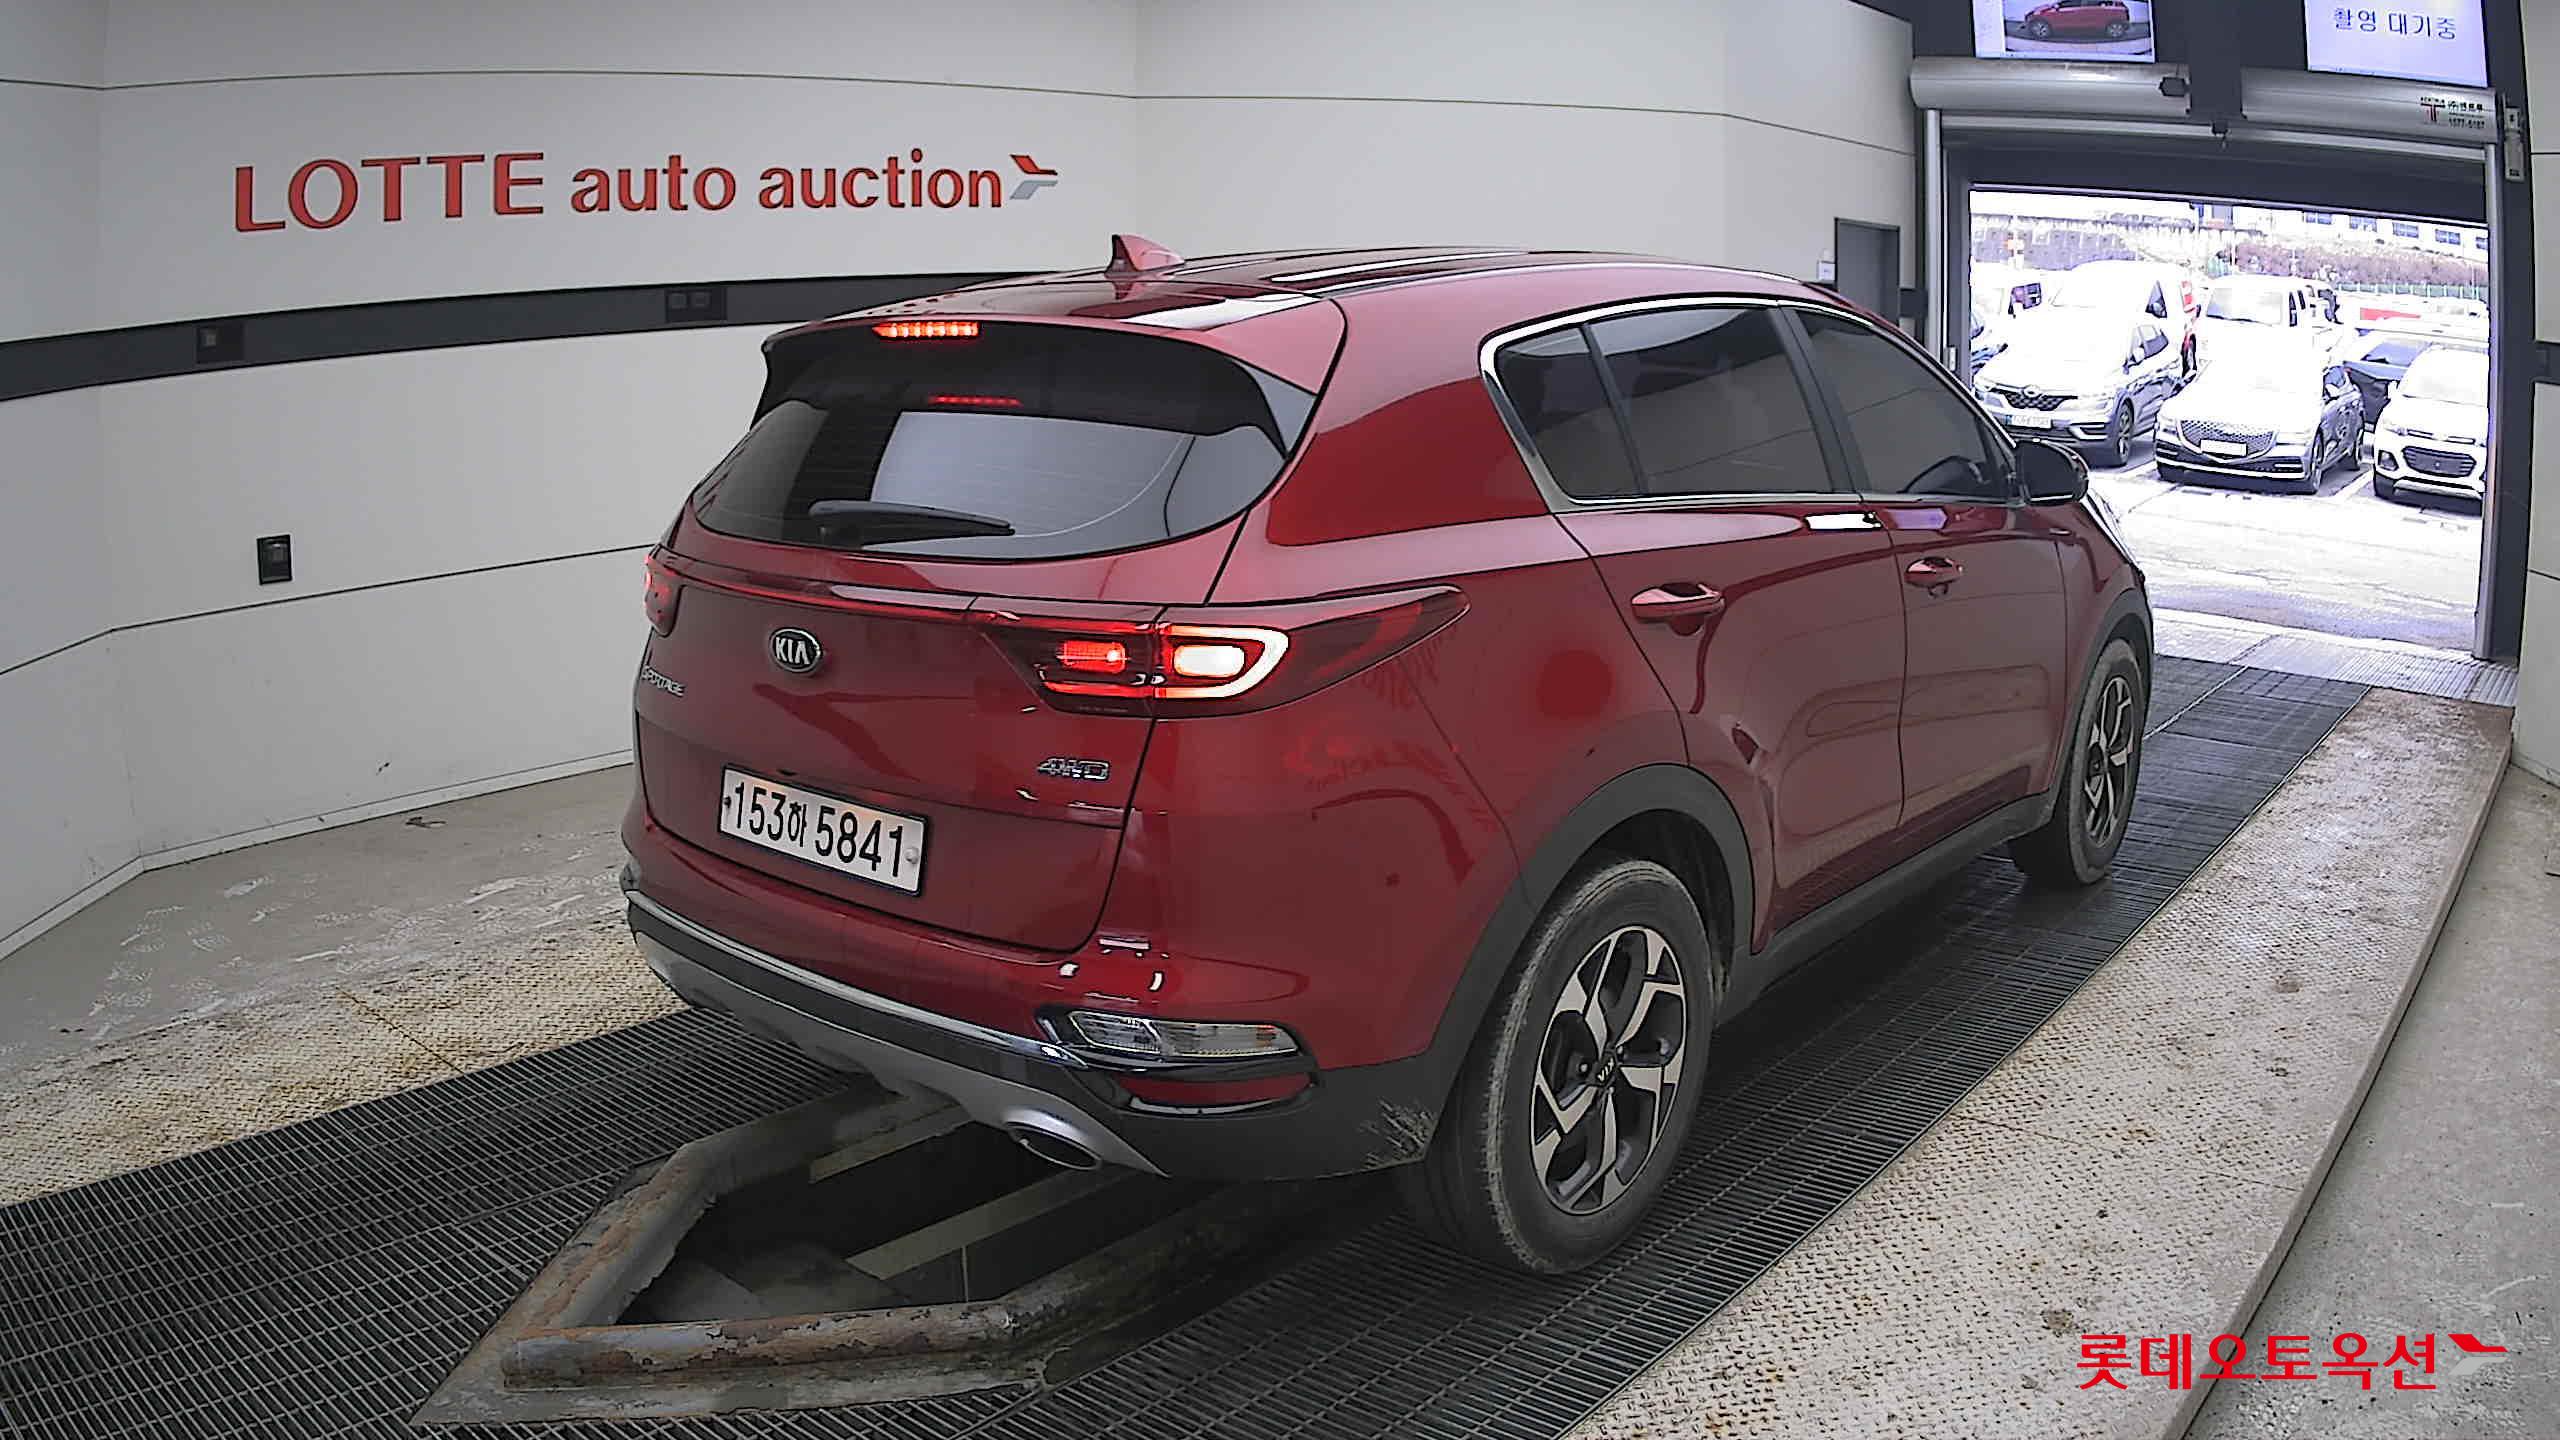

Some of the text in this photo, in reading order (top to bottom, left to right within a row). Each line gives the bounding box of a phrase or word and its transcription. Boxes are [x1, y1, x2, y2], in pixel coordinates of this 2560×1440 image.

[2388, 12, 2456, 40] 대기중
[235, 148, 1003, 231] LOTTE auto auction
[775, 636, 811, 665] KIA
[1037, 758, 1109, 780] 4WD
[735, 782, 903, 877] 153하 5841
